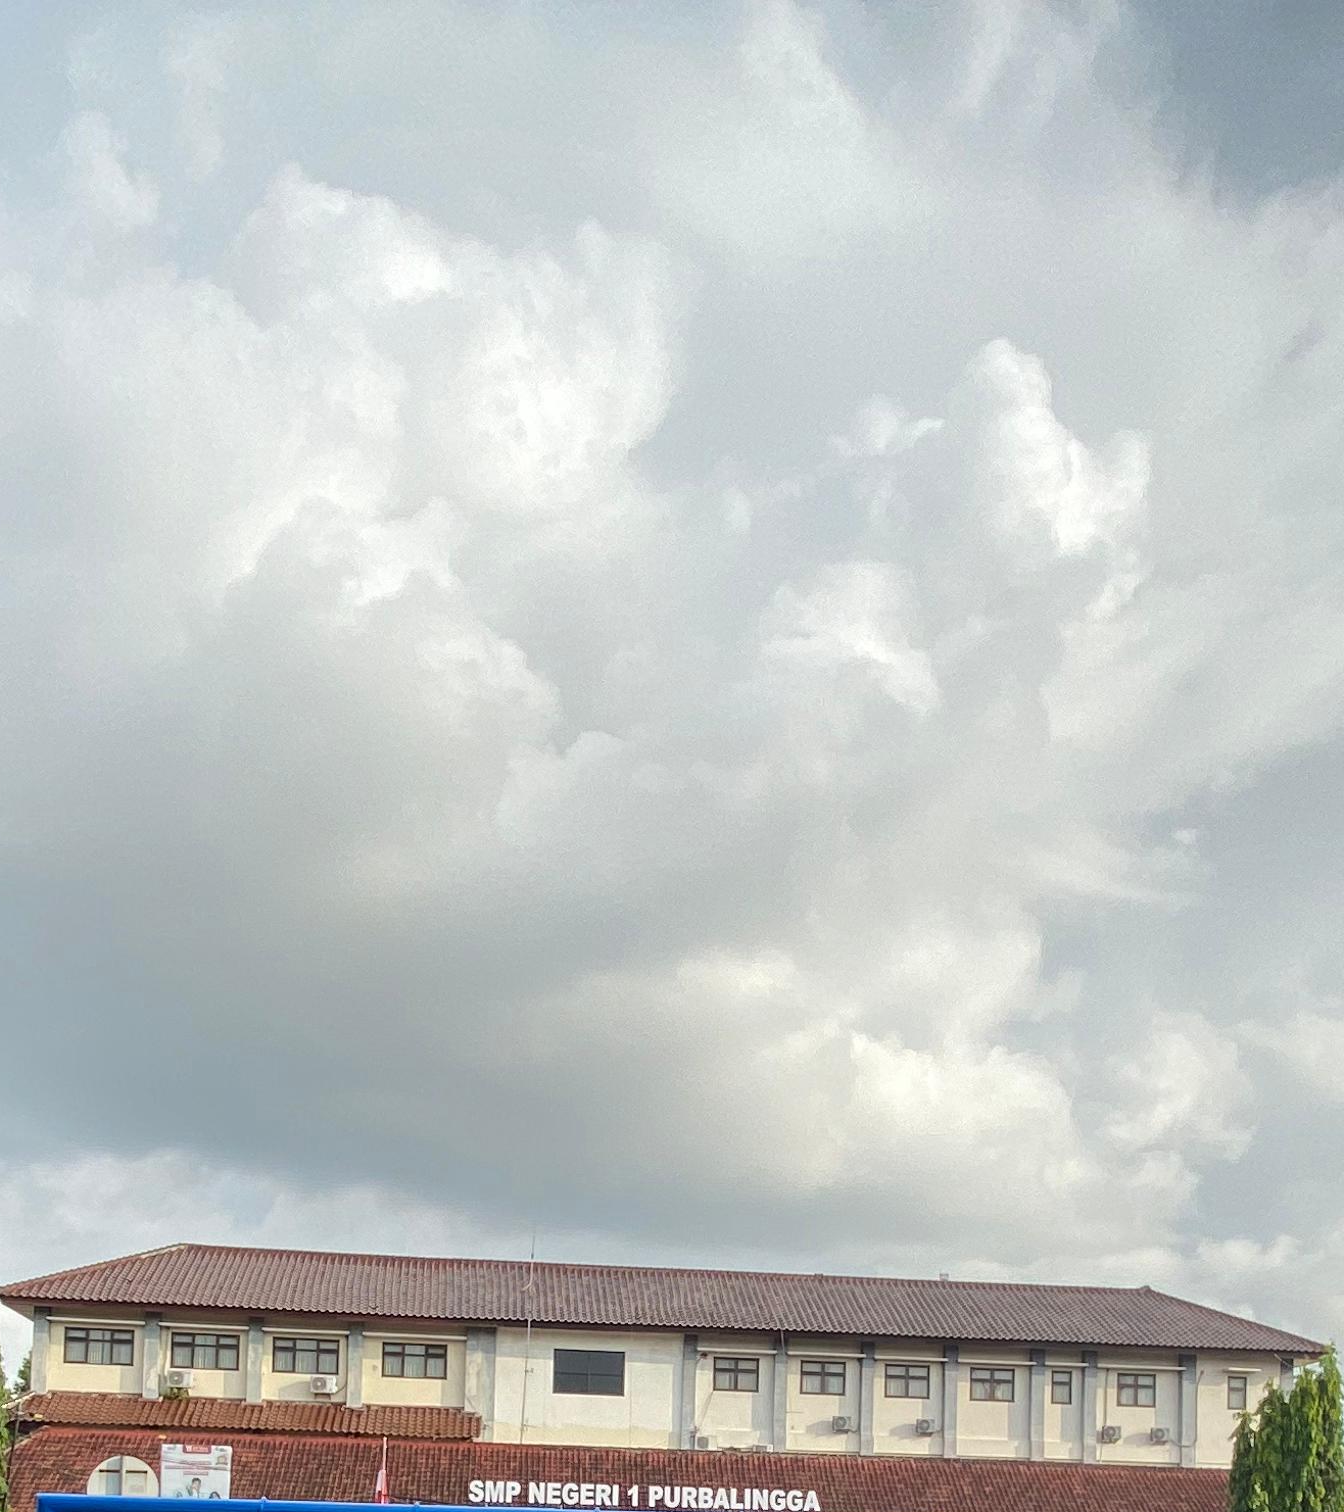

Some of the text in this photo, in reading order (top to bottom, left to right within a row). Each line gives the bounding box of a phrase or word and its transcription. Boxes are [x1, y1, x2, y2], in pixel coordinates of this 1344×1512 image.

[468, 1480, 821, 1512] SMP NEGERI 1 PURBALINGGA
